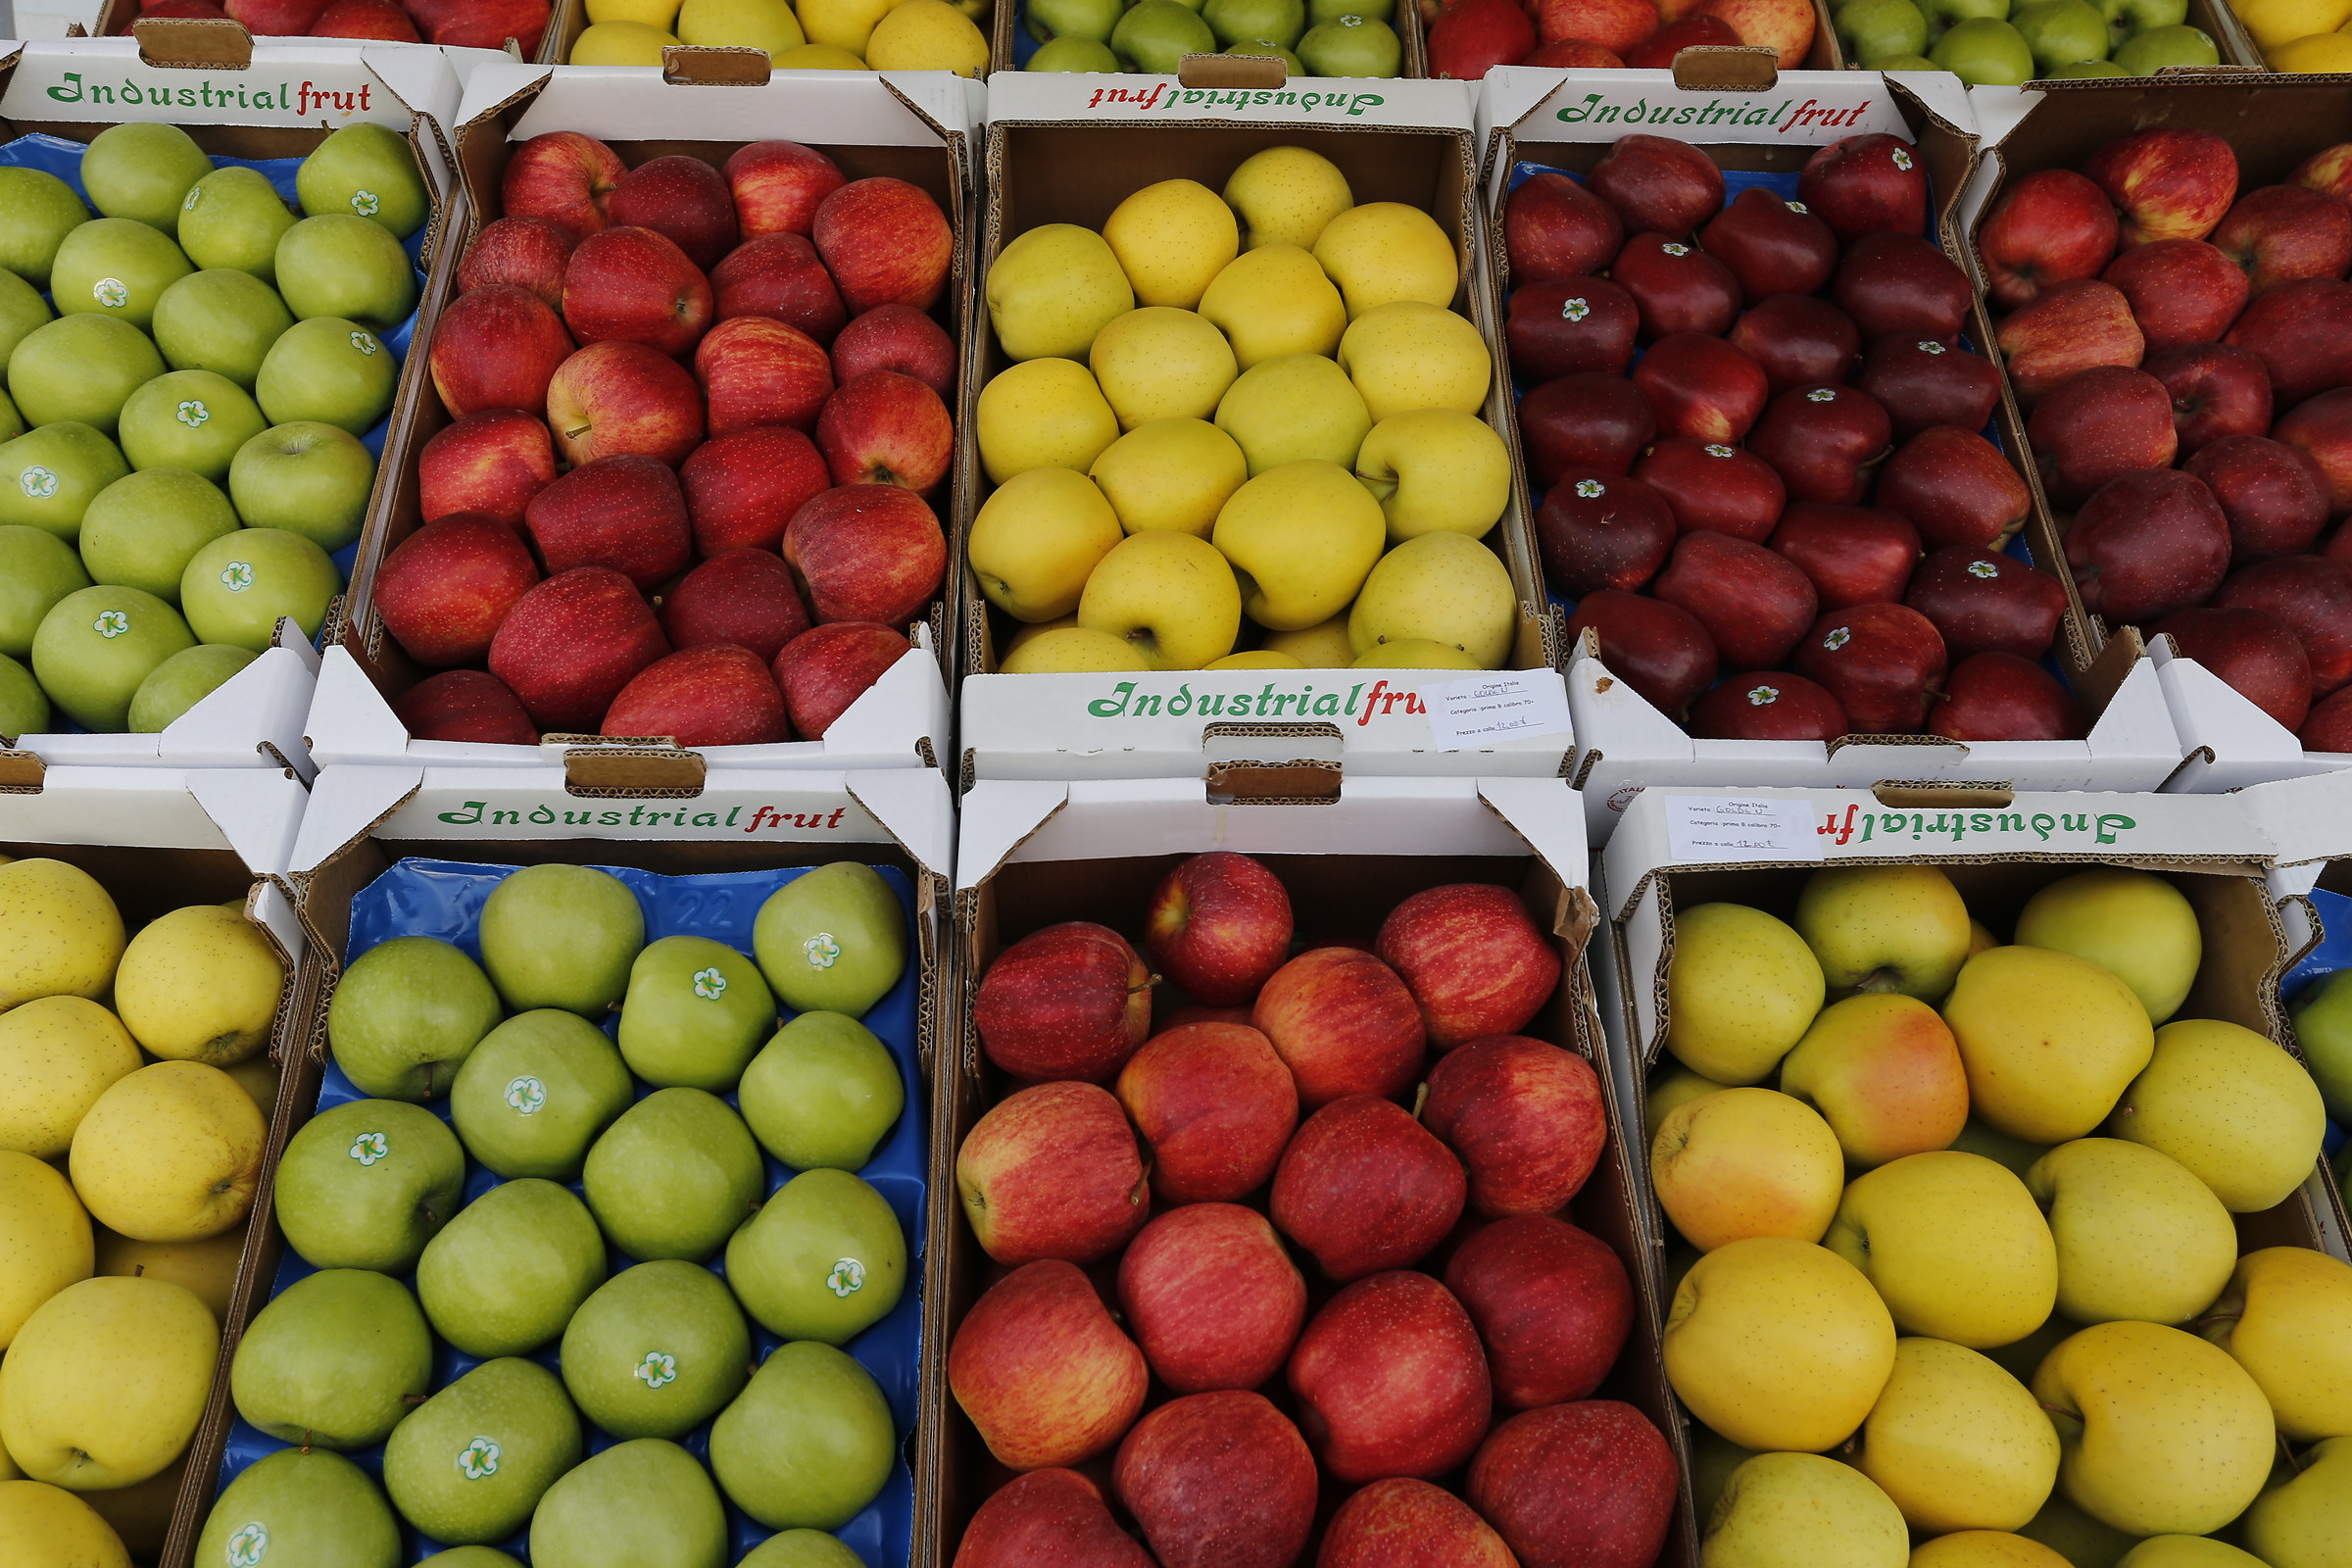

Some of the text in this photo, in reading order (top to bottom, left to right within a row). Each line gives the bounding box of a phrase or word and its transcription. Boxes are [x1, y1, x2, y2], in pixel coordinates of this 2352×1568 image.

[1087, 680, 1428, 725] Industrialfru
[1449, 708, 1477, 716] Categoria
[1455, 728, 1476, 737] Prezzo
